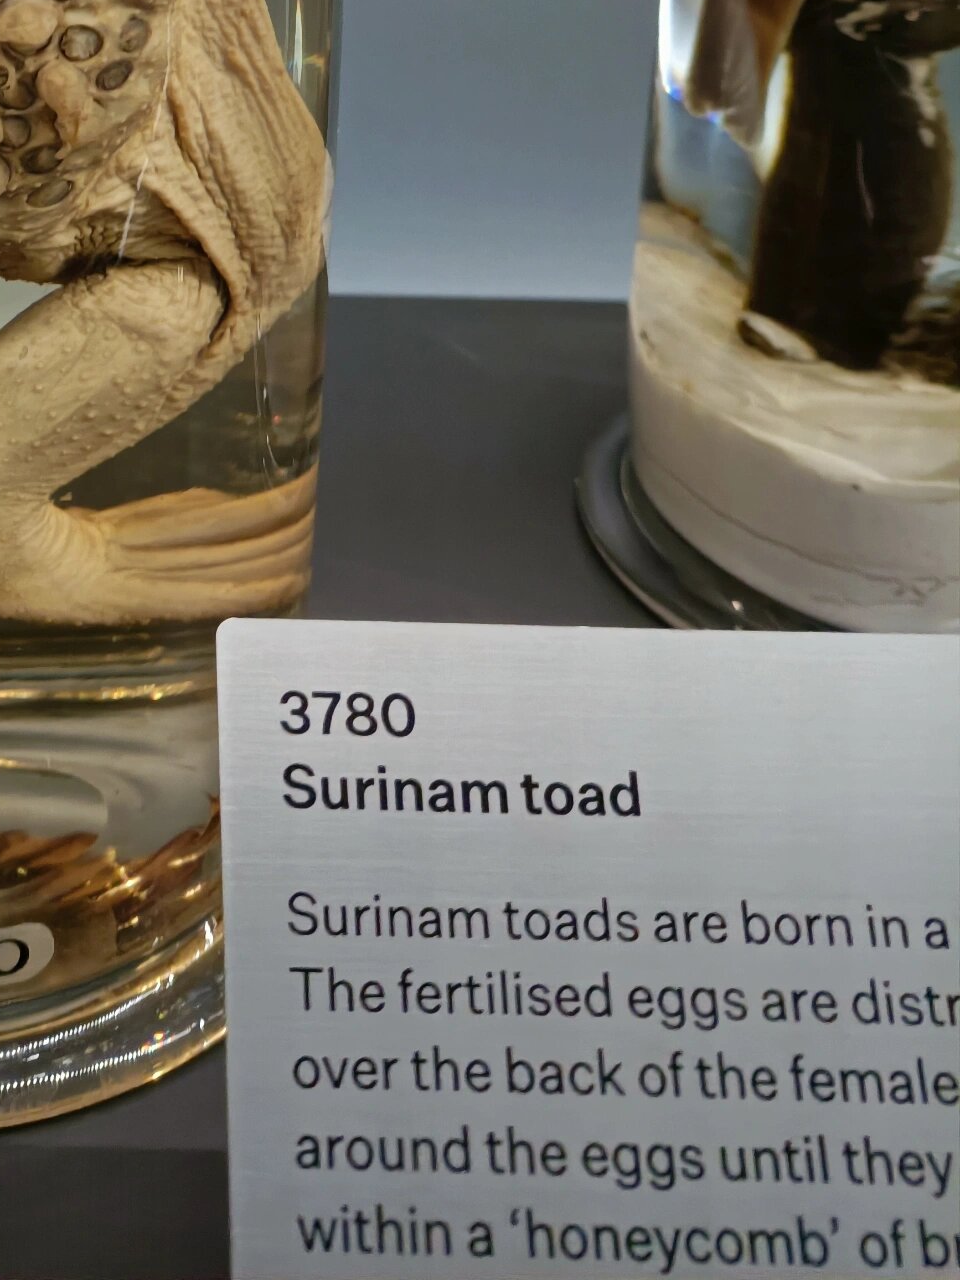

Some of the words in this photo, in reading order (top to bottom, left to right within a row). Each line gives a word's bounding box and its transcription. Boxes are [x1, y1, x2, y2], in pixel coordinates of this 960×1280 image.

[279, 689, 416, 739] 3780
[282, 762, 510, 815] Surinam
[519, 769, 642, 818] toad
[287, 890, 491, 940] Surinam
[501, 896, 640, 943] toads
[653, 910, 729, 945] are
[740, 898, 854, 948] born
[865, 903, 910, 949] in
[923, 916, 950, 950] a
[288, 966, 386, 1014] The
[397, 966, 613, 1018] fertilised
[627, 985, 749, 1032] eggs
[761, 988, 839, 1024] are
[292, 1055, 400, 1091] over
[409, 1044, 493, 1094] the
[504, 1045, 626, 1097] back
[637, 1050, 684, 1098] of
[694, 1050, 779, 1102] the
[788, 1052, 960, 1107] female
[295, 1123, 472, 1175] around
[484, 1125, 568, 1177] the
[580, 1141, 706, 1192] eggs
[719, 1133, 830, 1185] until
[841, 1135, 953, 1199] they
[296, 1203, 453, 1257] within
[467, 1220, 495, 1259] a
[858, 1218, 906, 1269] of
[917, 1218, 960, 1269] b
